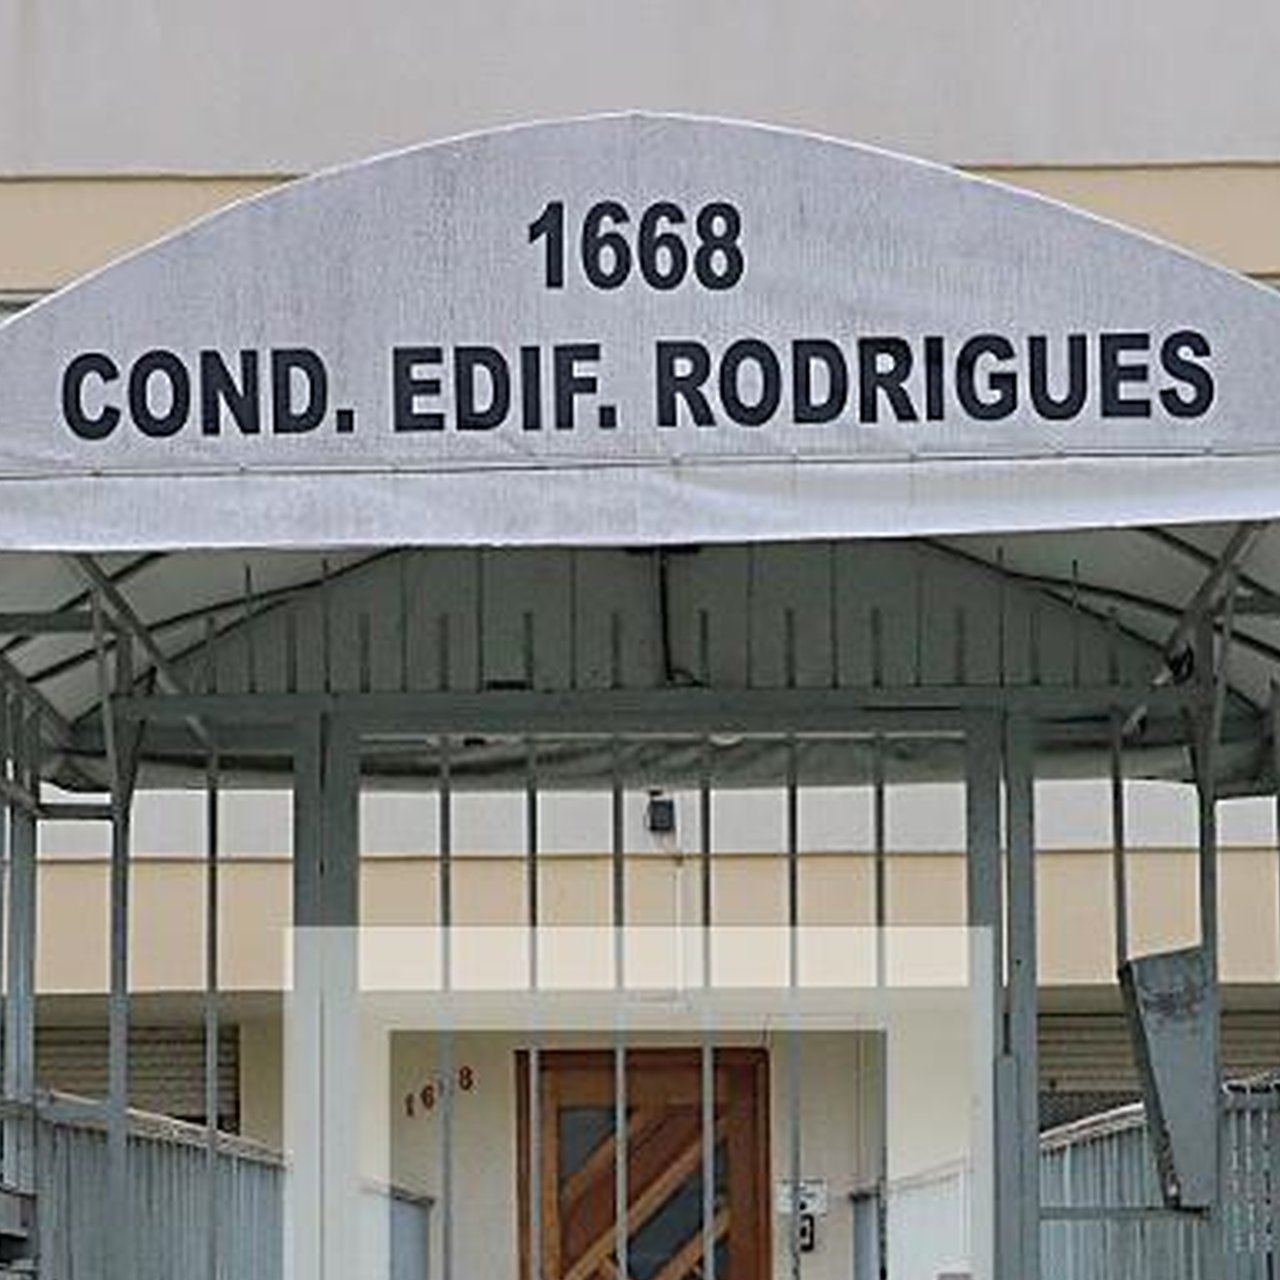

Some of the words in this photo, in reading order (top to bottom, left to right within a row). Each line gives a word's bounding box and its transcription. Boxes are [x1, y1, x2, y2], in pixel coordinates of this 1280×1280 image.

[529, 201, 743, 290] 1668
[63, 349, 354, 440] COND.
[393, 344, 616, 432] EDIF.
[656, 331, 1214, 427] RODRIGUES
[404, 1066, 473, 1117] 168
